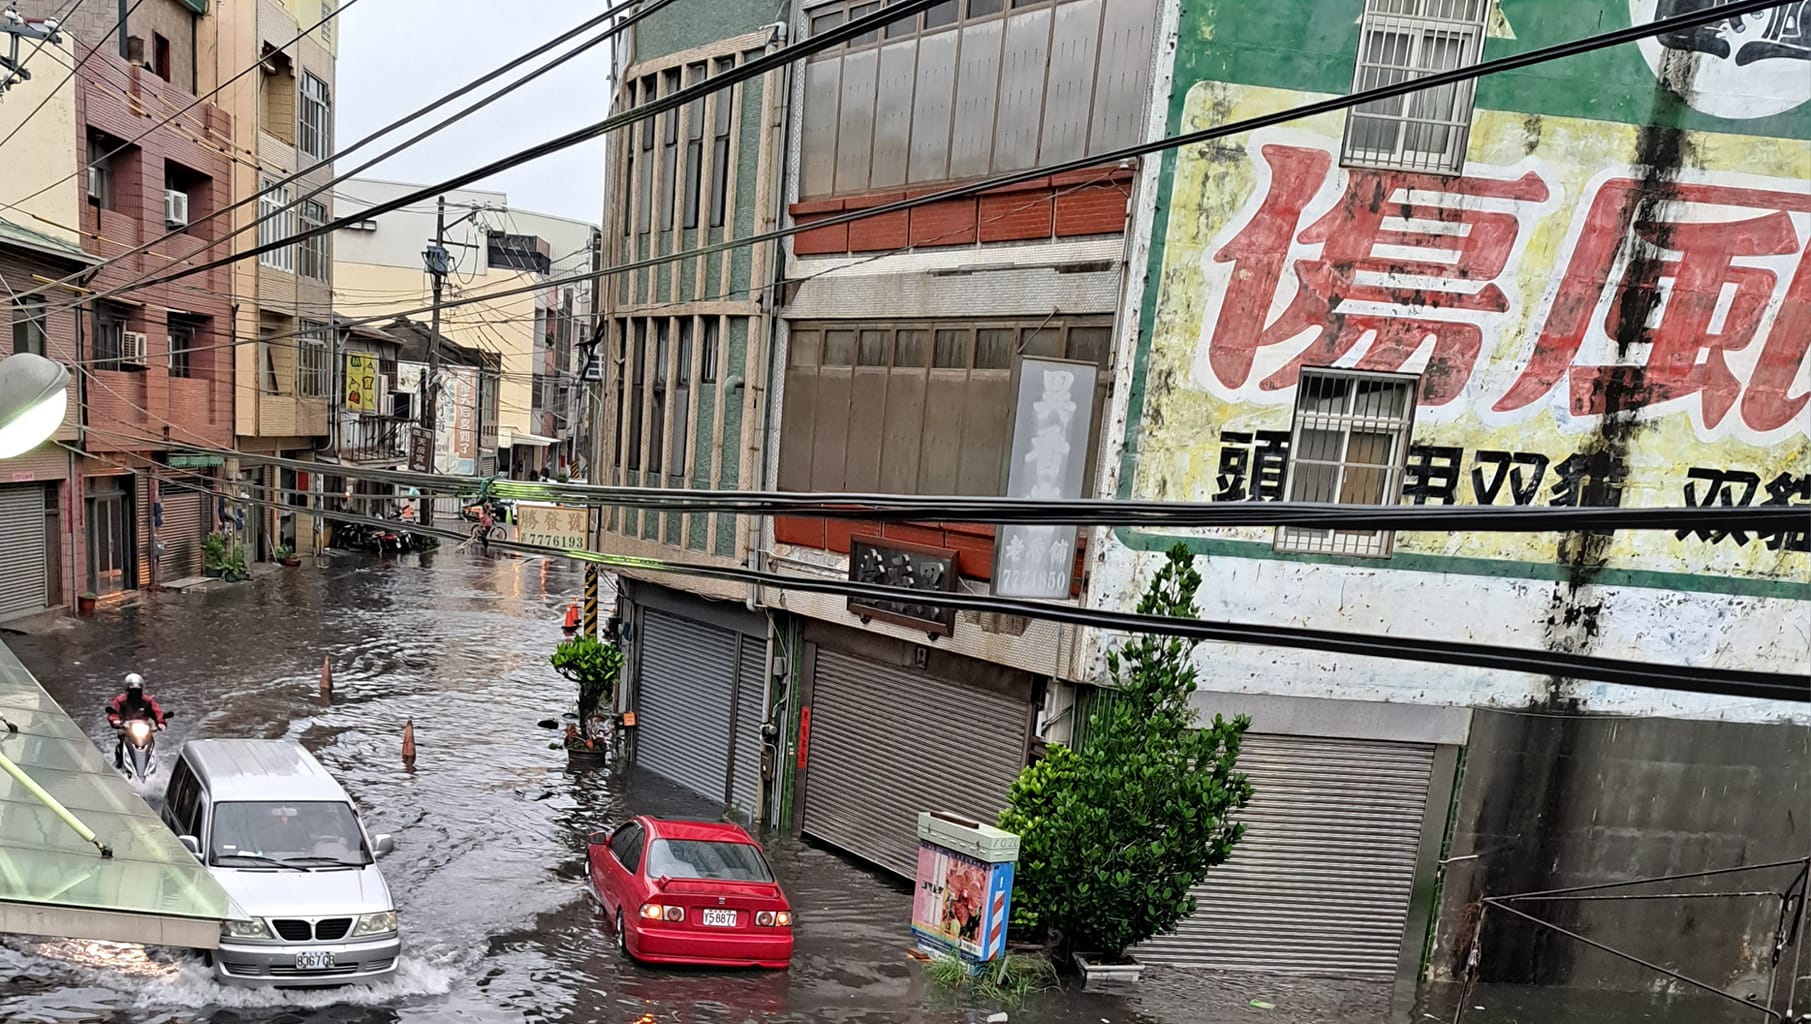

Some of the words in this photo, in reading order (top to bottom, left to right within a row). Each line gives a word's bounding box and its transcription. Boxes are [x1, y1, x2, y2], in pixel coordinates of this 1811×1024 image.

[520, 509, 585, 533] 勝發號
[529, 533, 584, 549] 7776193
